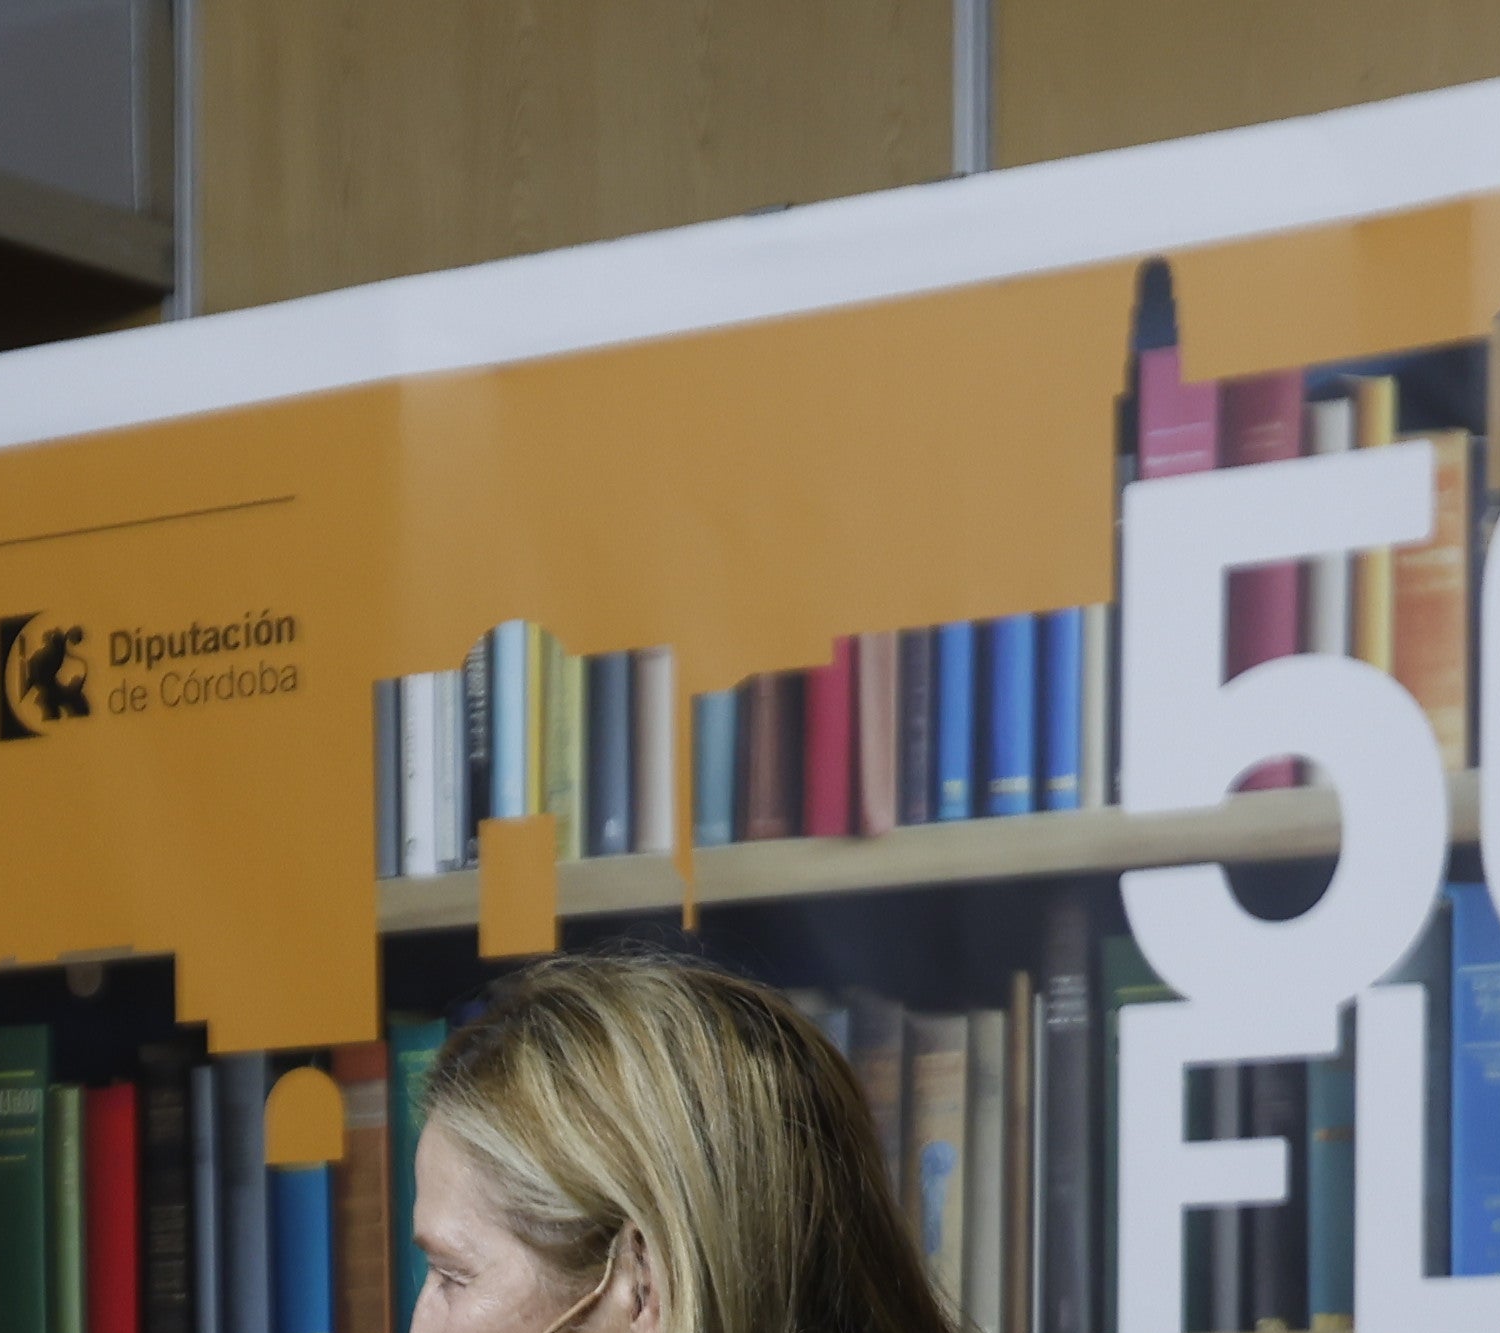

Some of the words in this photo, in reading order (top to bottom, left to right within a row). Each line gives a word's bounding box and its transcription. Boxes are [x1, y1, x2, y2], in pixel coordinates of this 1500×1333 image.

[109, 608, 297, 669] Diputación
[107, 677, 148, 715] de
[159, 660, 298, 708] Córdoba
